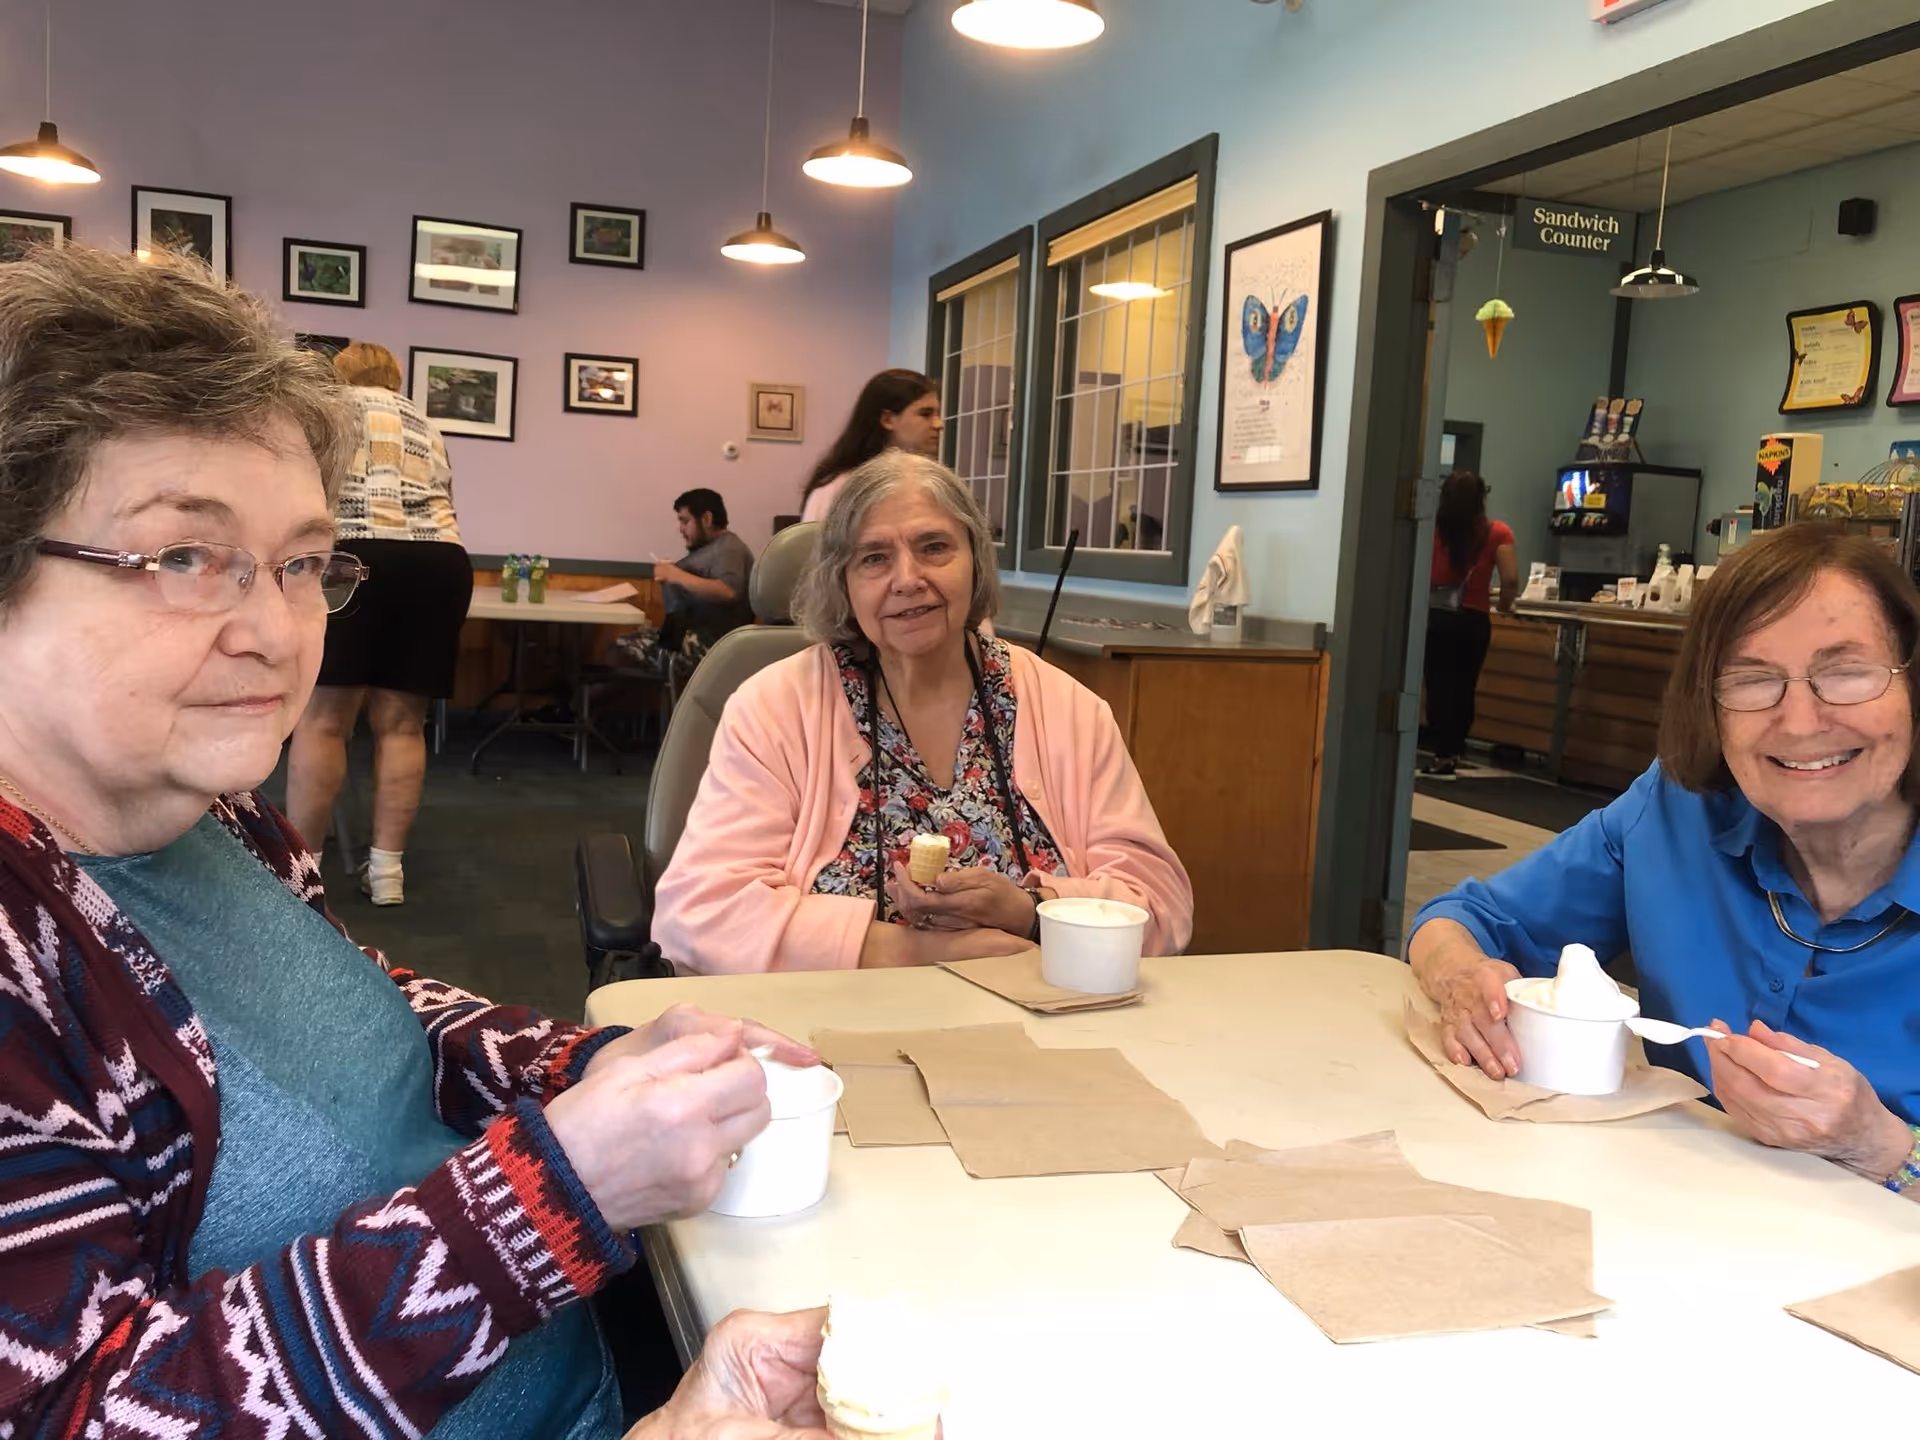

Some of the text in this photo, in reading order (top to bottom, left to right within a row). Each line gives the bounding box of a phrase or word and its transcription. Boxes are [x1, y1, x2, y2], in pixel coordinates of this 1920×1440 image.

[1533, 207, 1619, 234] Sandwich
[1540, 227, 1611, 251] Counter
[1758, 448, 1790, 460] NAPKINS
